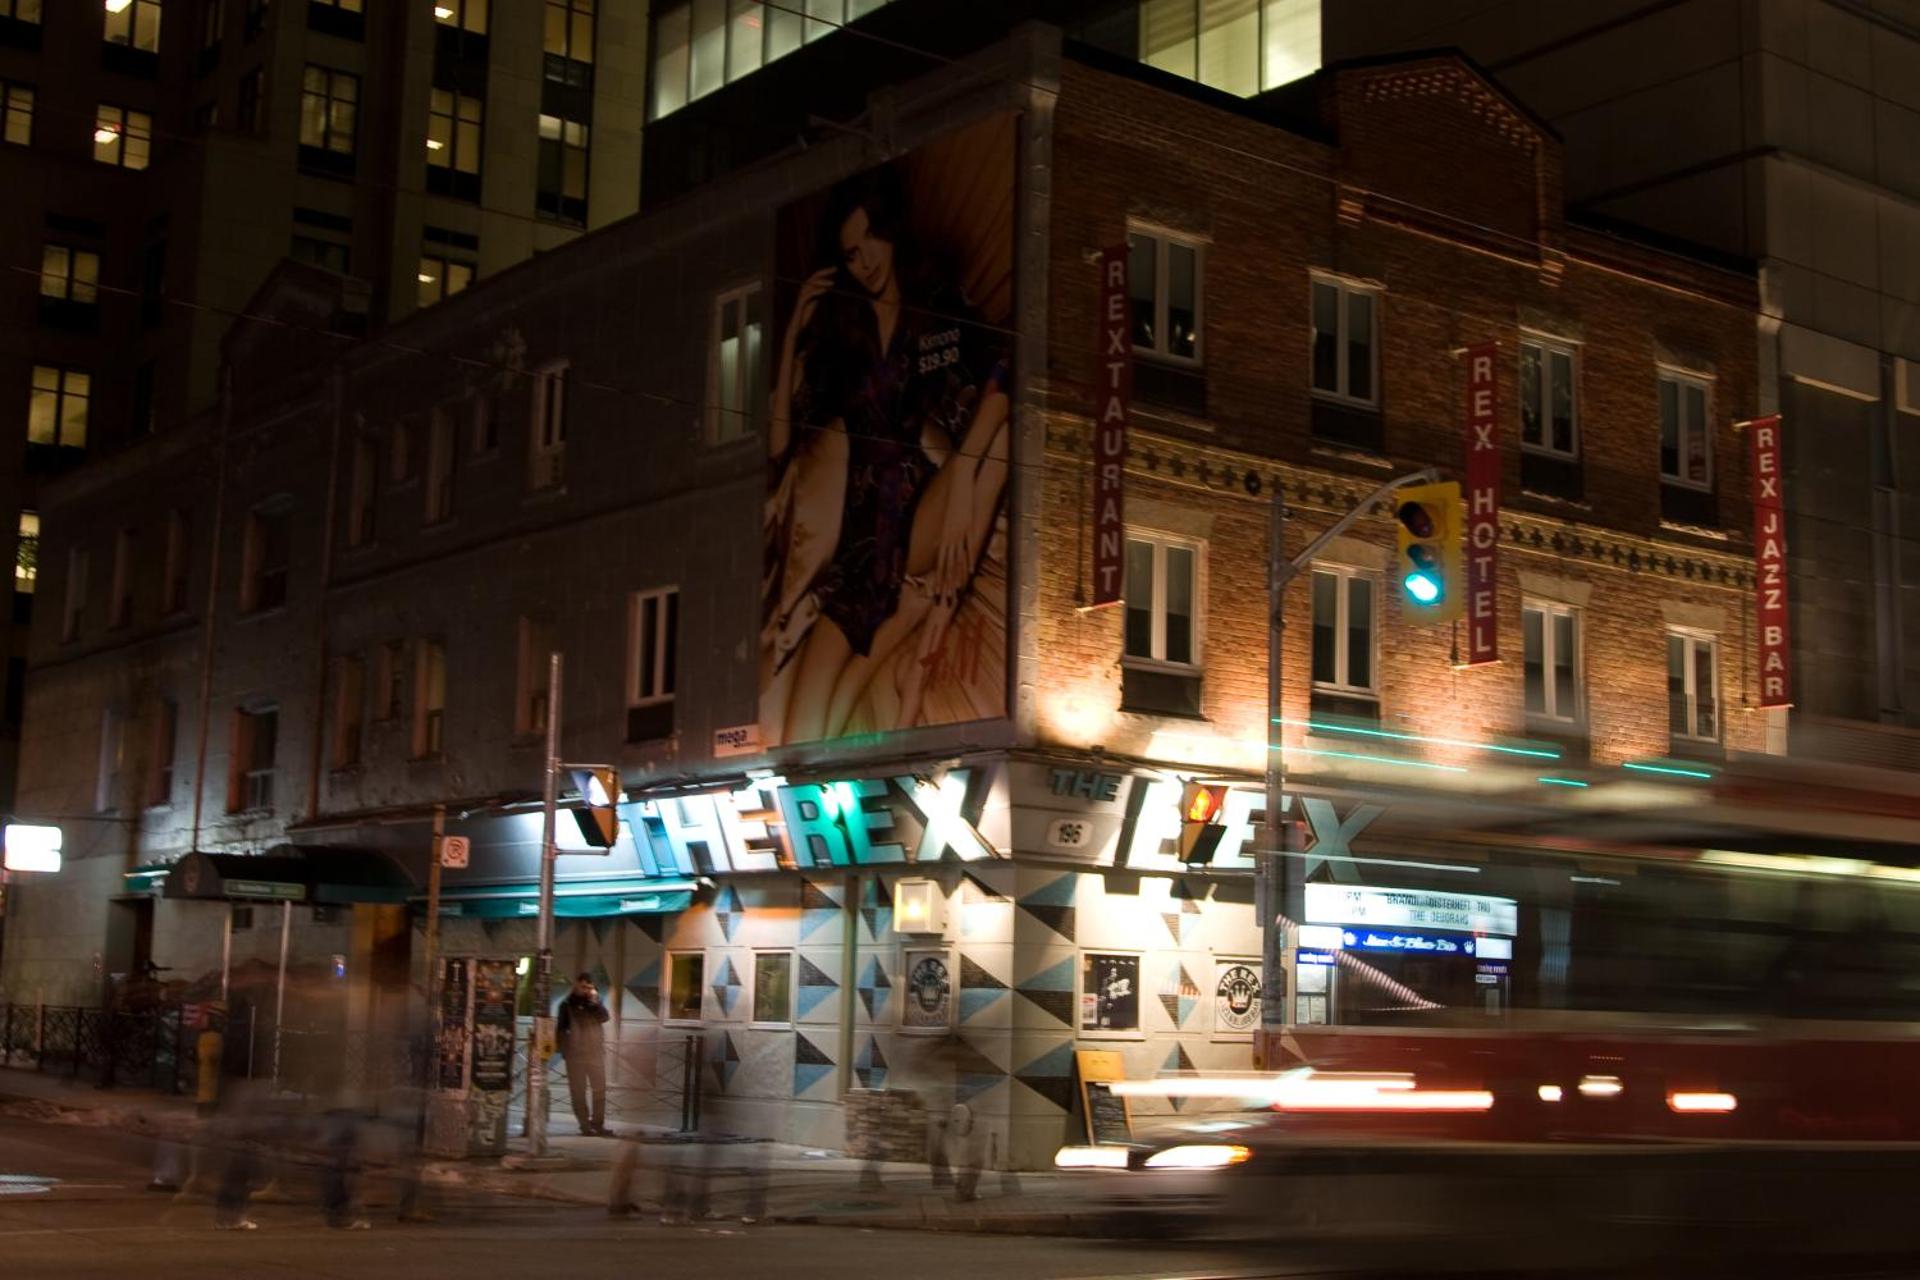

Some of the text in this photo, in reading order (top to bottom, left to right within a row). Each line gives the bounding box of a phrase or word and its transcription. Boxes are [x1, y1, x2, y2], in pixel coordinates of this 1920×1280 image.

[1100, 259, 1126, 594] REXTAURANT
[1472, 355, 1496, 653] REX HOTEL
[1756, 427, 1785, 698] REX JAZZ BAR
[616, 767, 1001, 877] THE REX
[1051, 768, 1122, 802] THE
[1219, 968, 1262, 993] THE REX
